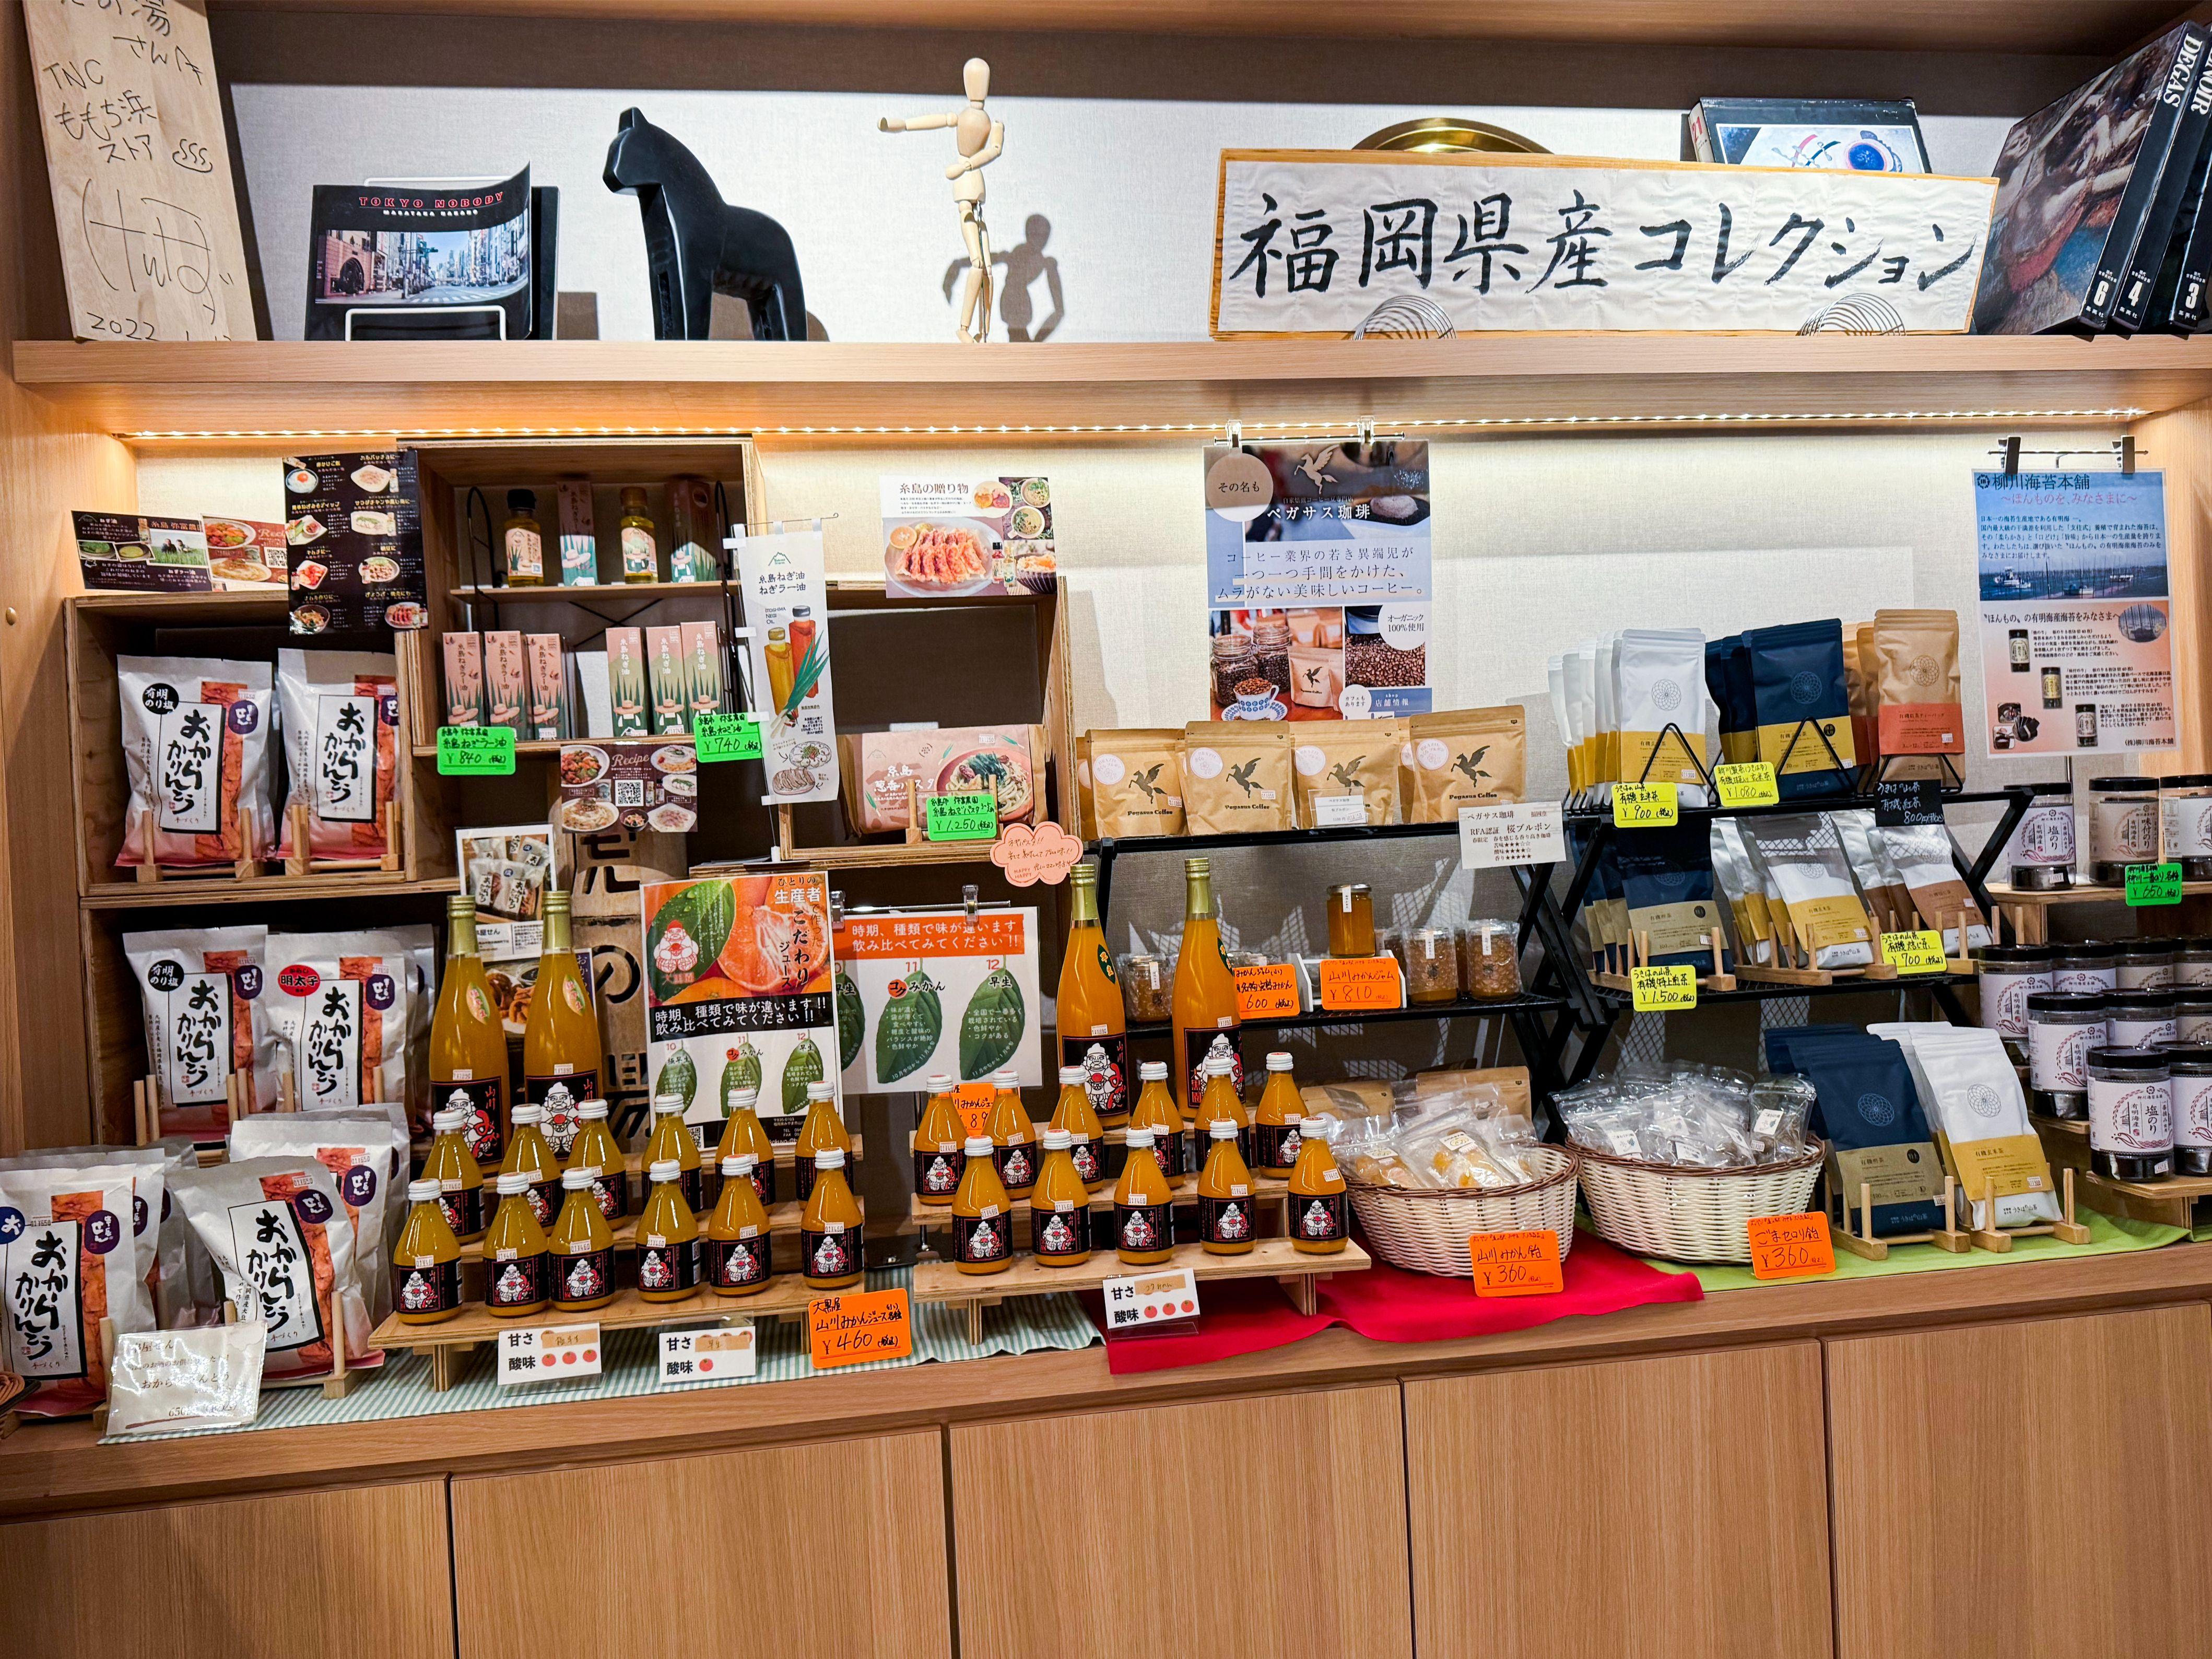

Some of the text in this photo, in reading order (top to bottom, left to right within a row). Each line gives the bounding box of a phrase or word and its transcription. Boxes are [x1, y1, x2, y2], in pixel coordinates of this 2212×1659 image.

[43, 59, 104, 89] TNC
[2163, 33, 2203, 107] DEGAS
[54, 90, 157, 141] ももち浜
[1692, 116, 1703, 143] 21
[99, 135, 152, 163] ストア
[359, 192, 505, 208] TOKYO NOBODY
[1228, 191, 1979, 298] 福岡県産コレクション
[2093, 280, 2109, 307] 6
[2128, 281, 2143, 307] 4
[2185, 283, 2199, 309] 3
[900, 484, 968, 494] 糸島の贈り物
[1218, 481, 1260, 493] その名も
[1993, 474, 2090, 491] 柳川海苔本舗
[1267, 504, 1371, 520] ペガサス珈琲
[1227, 547, 1414, 563] コーヒー業界の若き異端児が
[759, 572, 805, 584] 糸島ねぎ油
[1235, 564, 1405, 581] 一つ一つ手間をかけた、
[760, 583, 806, 595] ねぎラー油
[1217, 584, 1422, 599] ムラがない美味しいコーヒー。
[1387, 614, 1424, 622] オーガニック
[1387, 623, 1425, 632] 100%使用
[611, 754, 650, 767] Recipe
[888, 764, 913, 778] 糸島
[1468, 810, 1514, 820] ペガサス珈琲
[1470, 823, 1551, 836] RFA認証 桜ブルボン
[2048, 825, 2060, 850] 塩のり
[2141, 818, 2152, 849] 味付のり
[778, 876, 816, 887] ひとりの
[774, 887, 821, 904] 生産者
[792, 910, 810, 986] こだわり
[852, 936, 1018, 952] 飲み比べてみてください!!
[779, 942, 792, 988] ジュース
[905, 961, 917, 973] 11
[986, 959, 1000, 970] 12
[280, 975, 319, 987] 明太子
[990, 976, 1012, 987] 早生
[1328, 969, 1395, 983] 山川みかんジャム
[889, 980, 945, 997] コクみかん
[728, 1048, 763, 1060] コクみかん
[2145, 1105, 2158, 1134] 塩のり
[1755, 1226, 1819, 1245] ごまセロリ飴
[31, 1230, 68, 1330] おから
[1111, 1285, 1134, 1300] 甘さ
[813, 1298, 841, 1315] 大黒屋
[14, 1272, 52, 1360] かりんとう
[1114, 1308, 1139, 1324] 酸味
[508, 1333, 533, 1347] 甘さ
[666, 1337, 691, 1351] 甘さ
[508, 1356, 536, 1371] 酸味
[666, 1360, 693, 1374] 酸味
